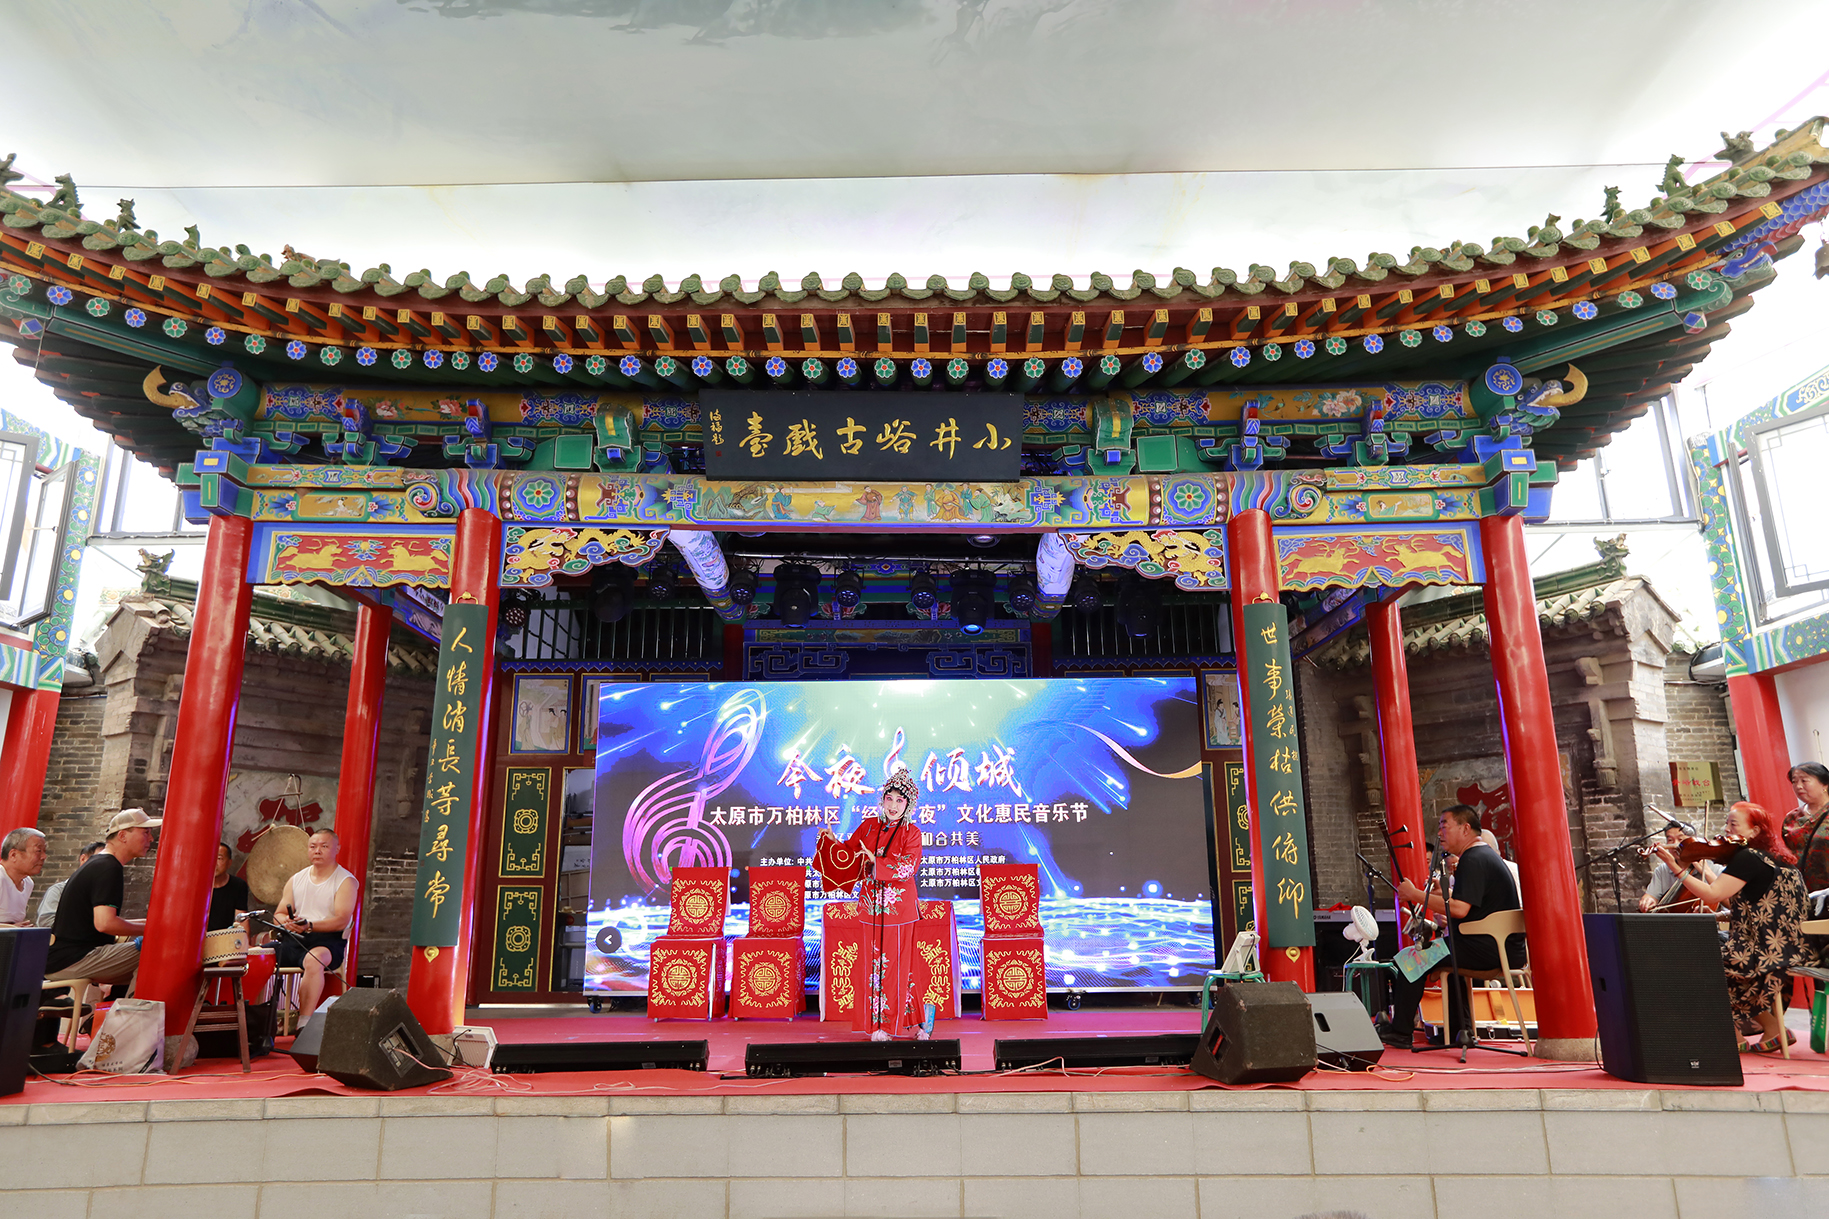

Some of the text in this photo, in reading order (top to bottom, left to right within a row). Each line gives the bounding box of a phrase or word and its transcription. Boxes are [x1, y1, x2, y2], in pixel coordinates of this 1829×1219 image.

[920, 855, 1006, 864] 太原市万柏林区人民政府
